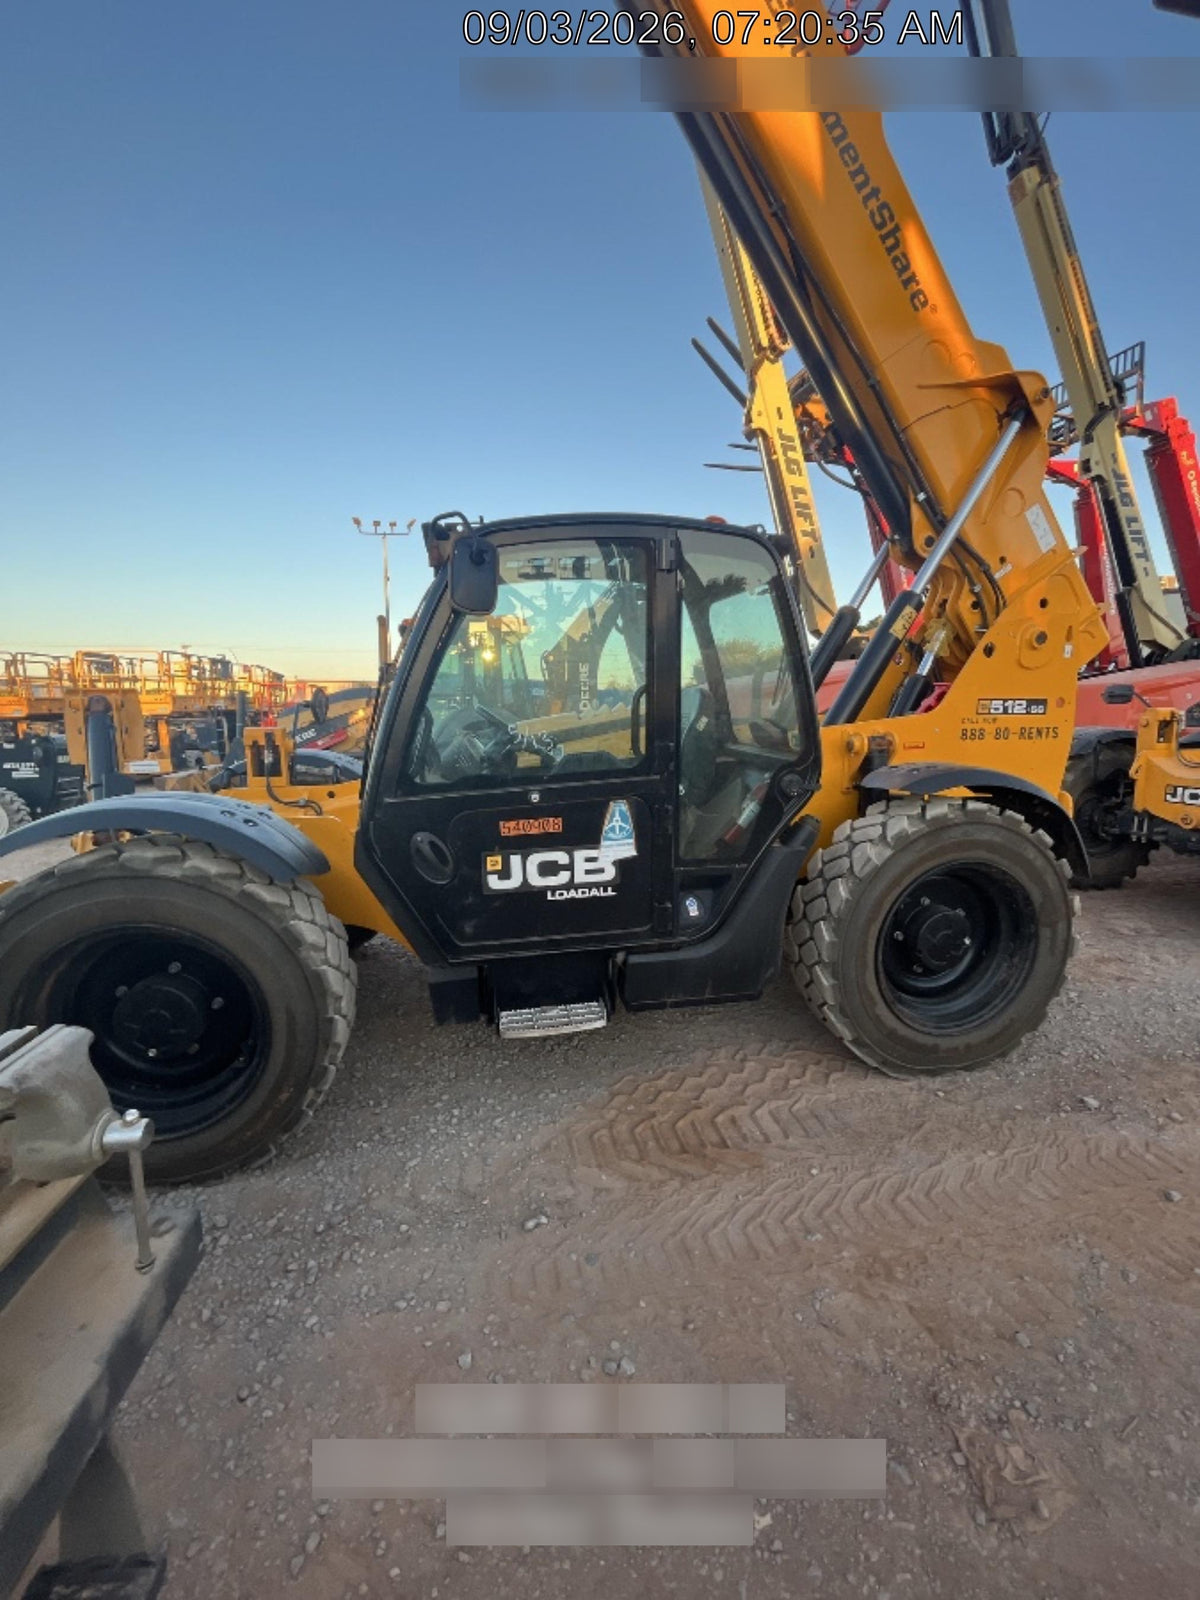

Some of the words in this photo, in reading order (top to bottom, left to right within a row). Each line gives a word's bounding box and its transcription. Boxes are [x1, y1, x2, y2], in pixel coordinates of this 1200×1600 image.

[819, 111, 930, 314] mentShare
[777, 427, 803, 477] JLG
[790, 485, 819, 544] LIFT
[1112, 472, 1135, 508] JLG
[1125, 516, 1150, 571] LIFT
[1166, 787, 1200, 806] JC
[486, 851, 616, 890] JCB
[547, 886, 618, 901] LOADALL
